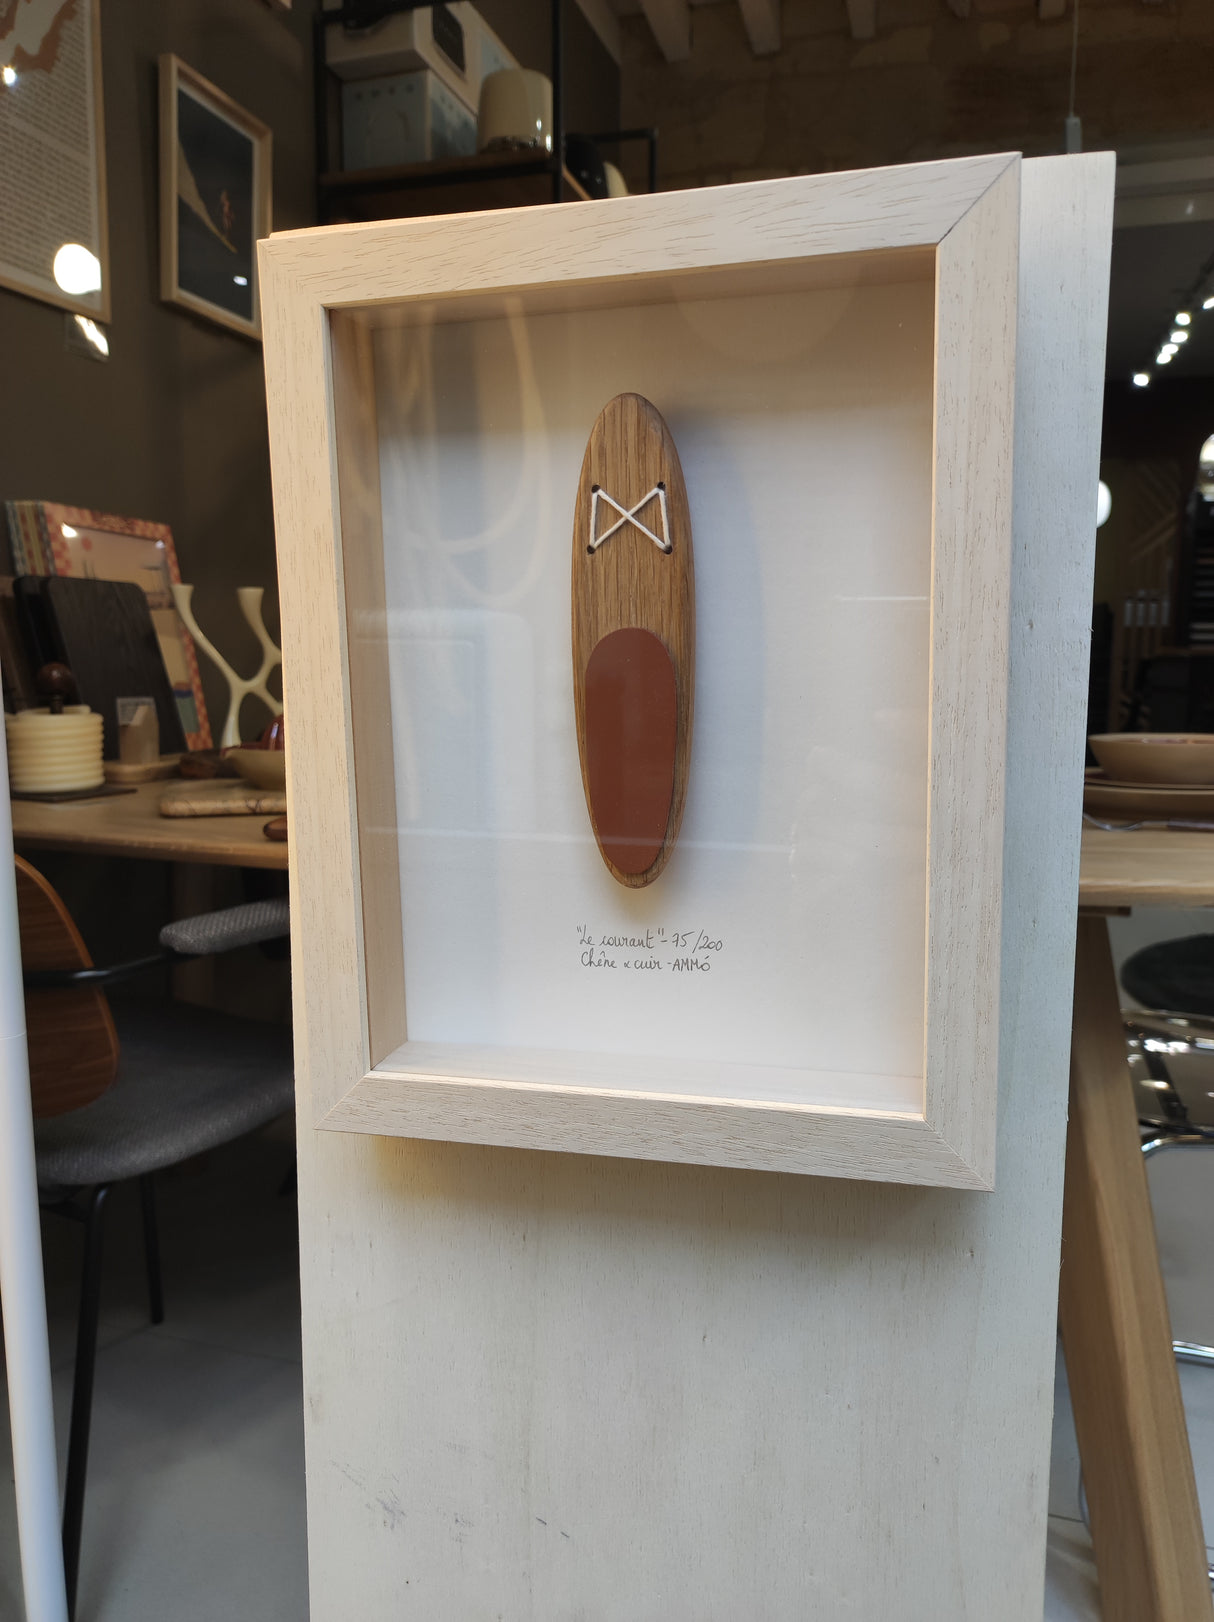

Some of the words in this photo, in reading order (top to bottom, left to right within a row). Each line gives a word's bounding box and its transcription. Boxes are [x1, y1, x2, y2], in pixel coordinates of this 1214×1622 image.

[672, 929, 723, 953] 75/200
[581, 947, 617, 969] Chêne
[634, 955, 663, 970] cuir
